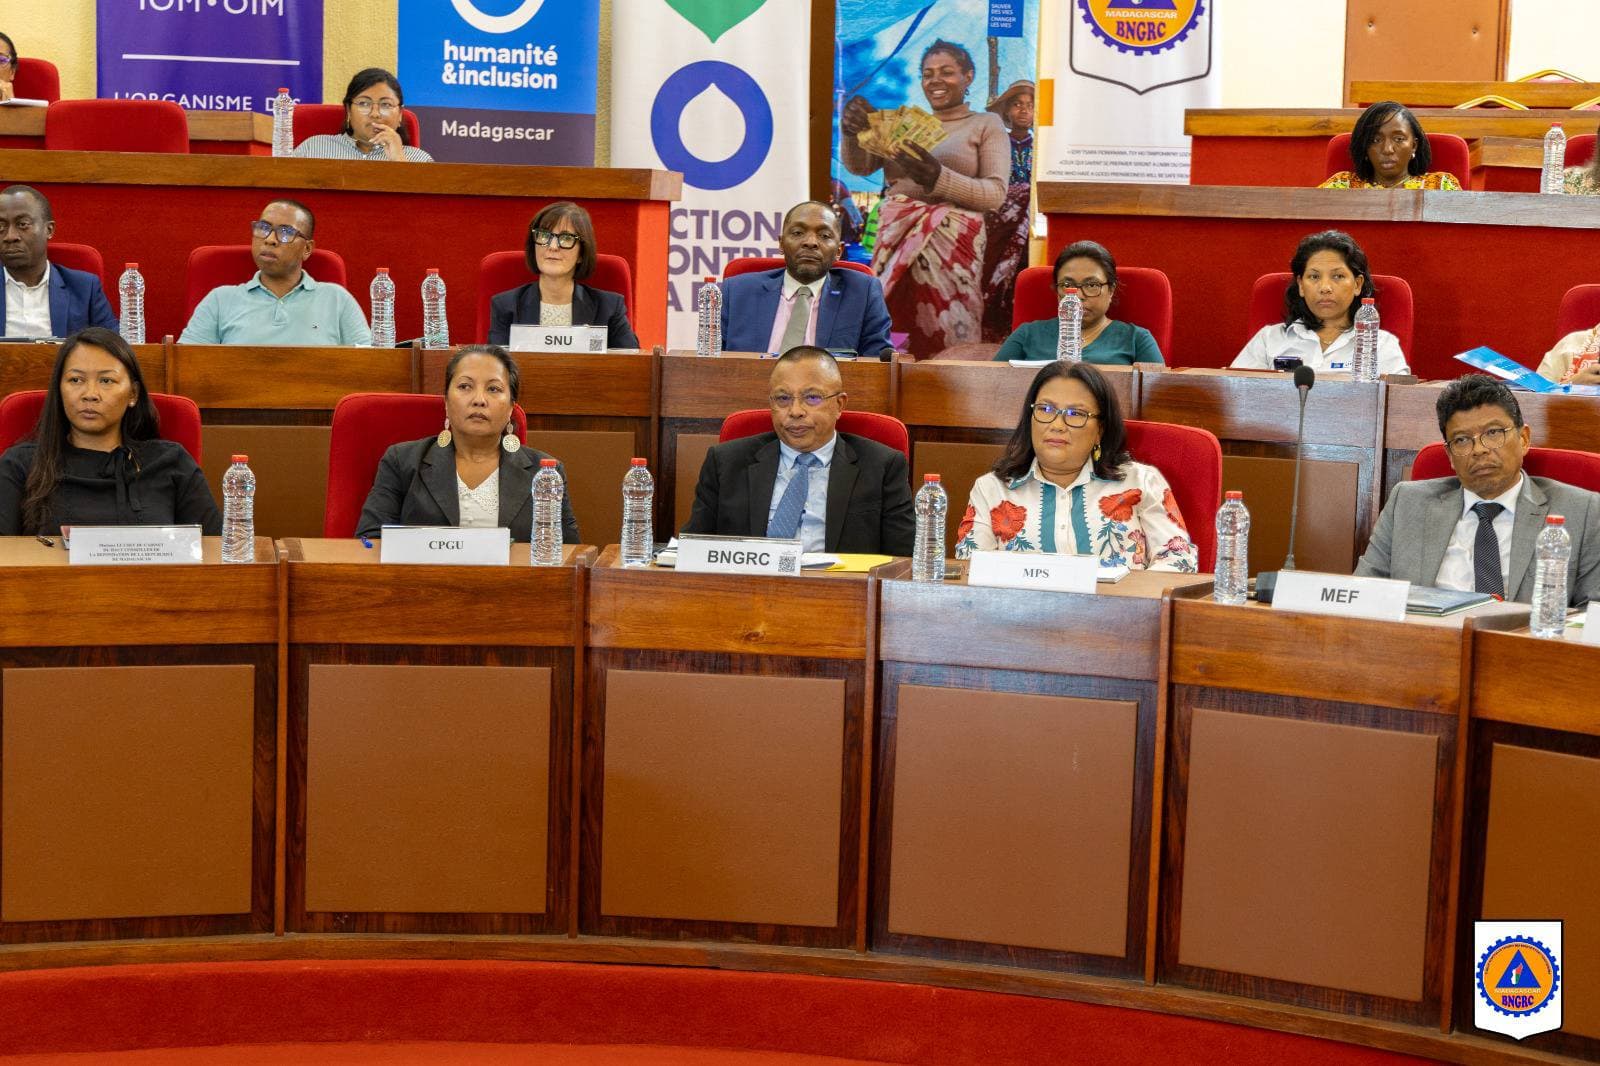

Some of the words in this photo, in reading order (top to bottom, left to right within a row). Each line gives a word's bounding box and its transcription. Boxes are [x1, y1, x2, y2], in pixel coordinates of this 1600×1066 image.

[1105, 10, 1178, 19] MADAGASCAR
[1116, 20, 1166, 41] BNGRC
[443, 39, 558, 66] humanité
[441, 62, 558, 89] &inclusion
[441, 120, 555, 142] Madagascar
[669, 208, 783, 241] CTION
[544, 335, 573, 346] SNU
[428, 540, 464, 550] CPGU
[707, 550, 770, 566] BNGRC
[1022, 568, 1050, 579] MPS
[1320, 587, 1360, 604] MEF
